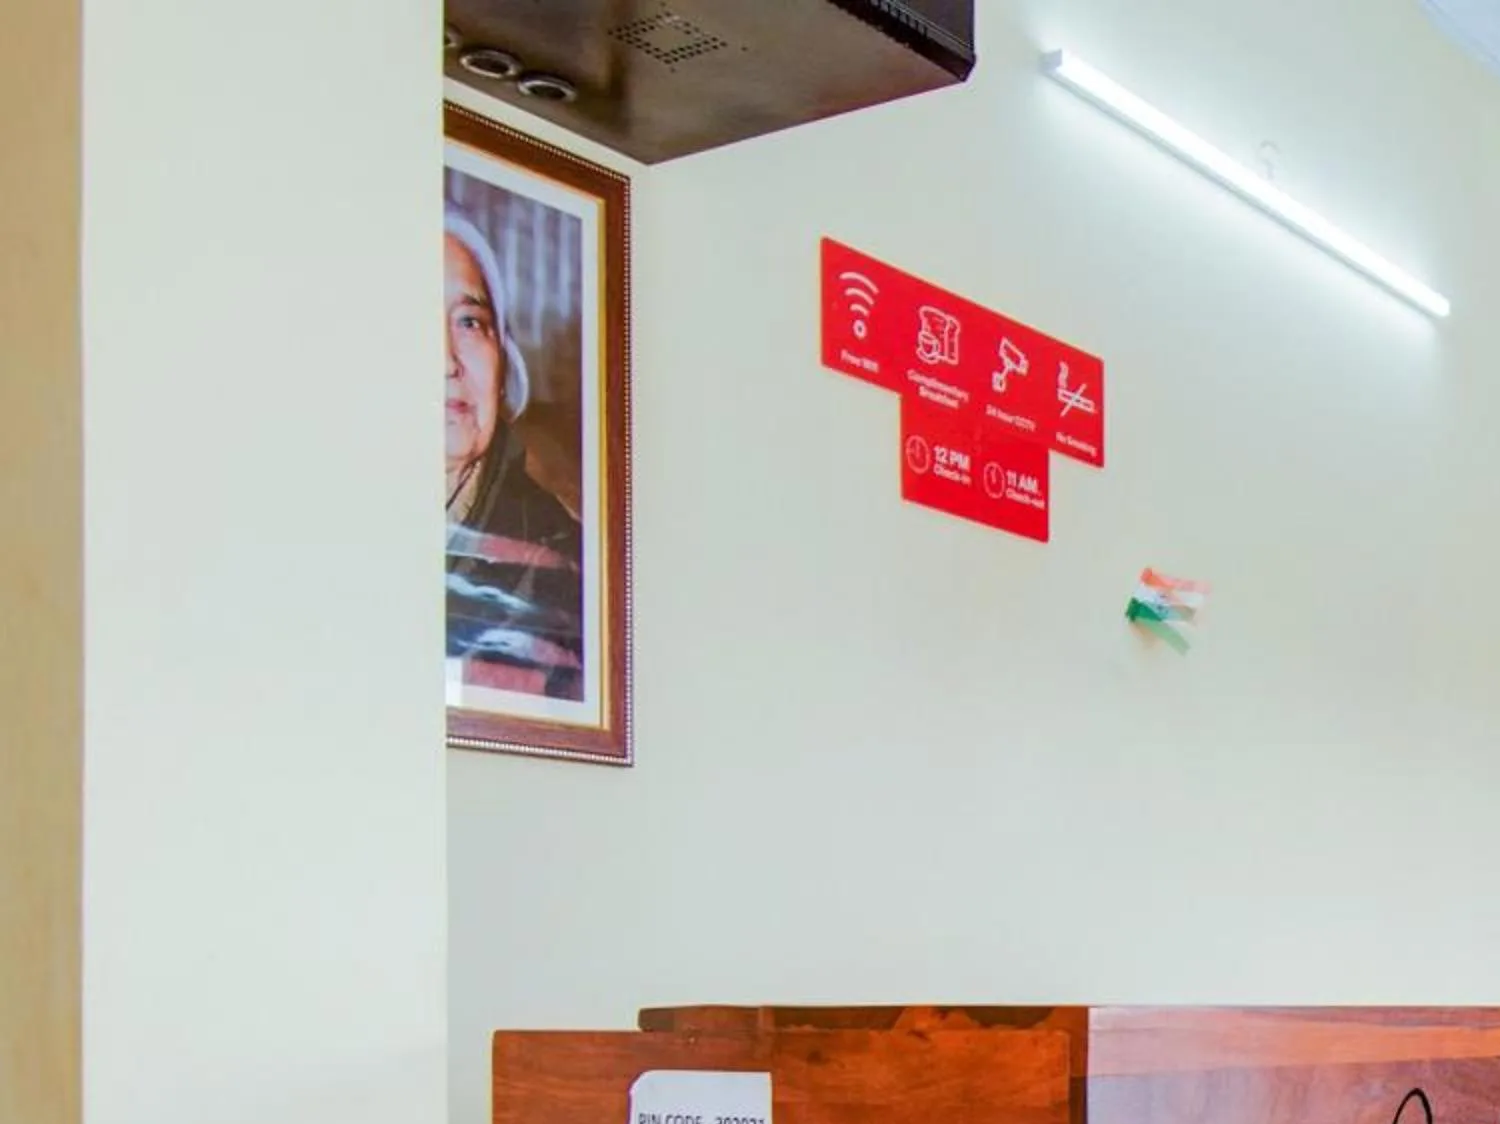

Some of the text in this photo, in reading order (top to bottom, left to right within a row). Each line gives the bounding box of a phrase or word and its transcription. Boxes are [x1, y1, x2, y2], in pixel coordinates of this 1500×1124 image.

[934, 445, 970, 471] 12 PM
[1006, 469, 1017, 487] 11
